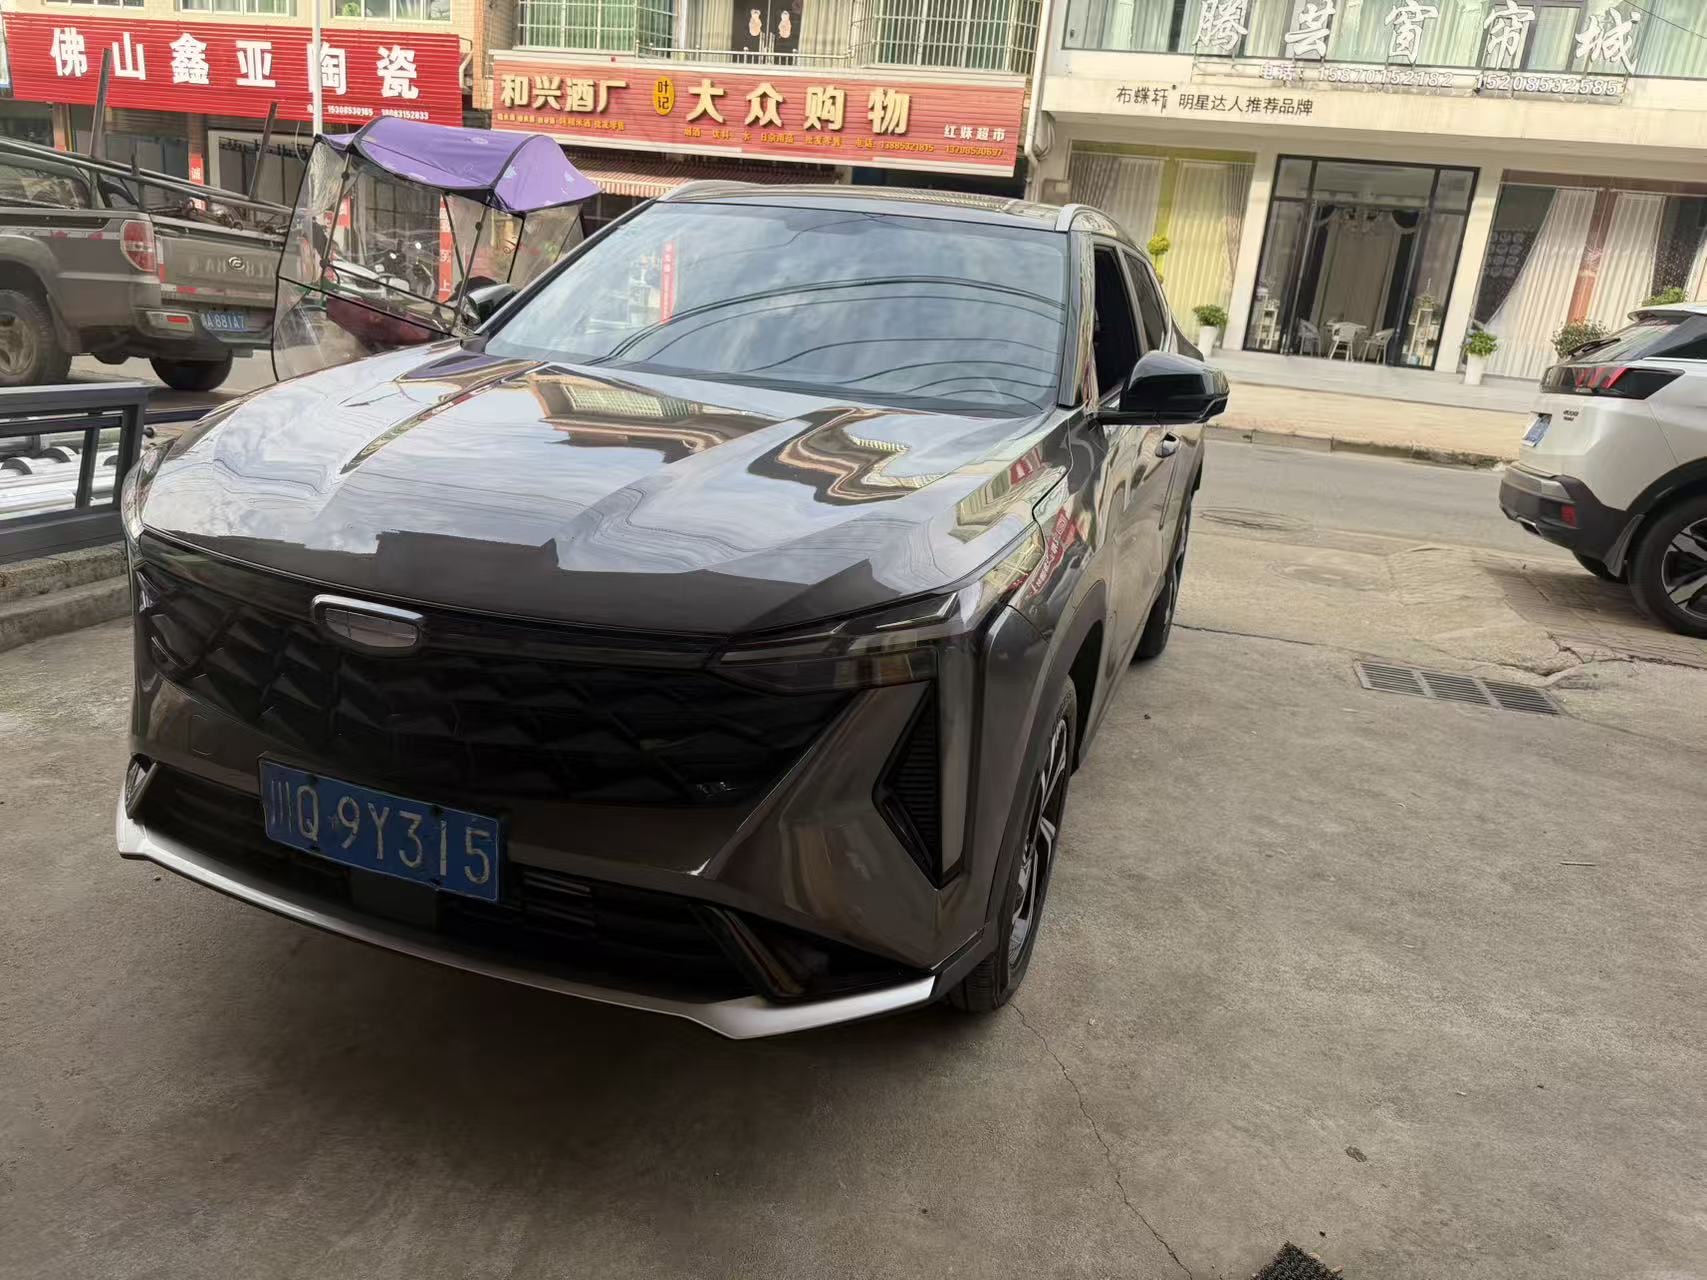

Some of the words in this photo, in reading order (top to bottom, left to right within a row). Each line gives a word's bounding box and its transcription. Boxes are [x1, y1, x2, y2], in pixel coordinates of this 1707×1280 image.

[50, 27, 419, 99] 佛山鑫亚陶瓷
[501, 74, 628, 114] 和兴酒厂
[658, 80, 670, 110] 叶记
[1318, 67, 1454, 87] 15870152182
[1476, 74, 1618, 95] 15208532585
[687, 79, 911, 135] 大众购物
[1179, 93, 1314, 116] 明星达人推荐品牌
